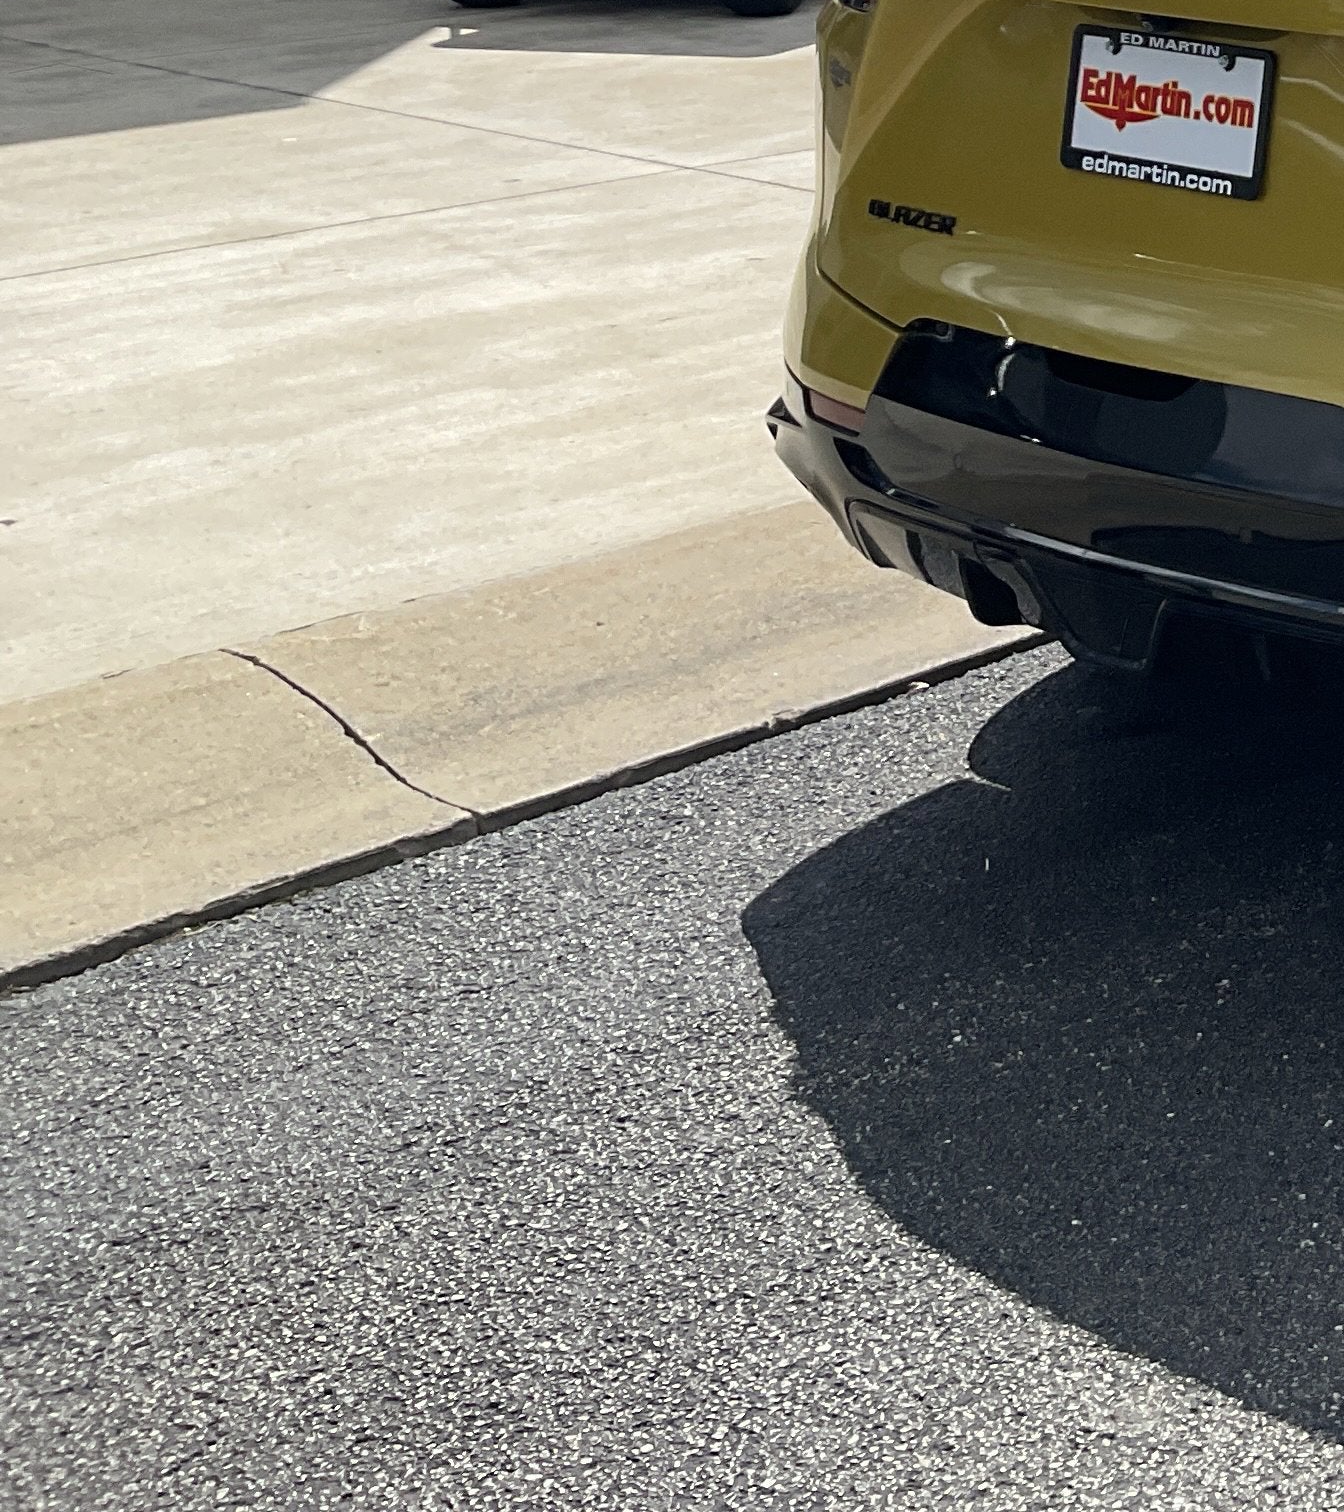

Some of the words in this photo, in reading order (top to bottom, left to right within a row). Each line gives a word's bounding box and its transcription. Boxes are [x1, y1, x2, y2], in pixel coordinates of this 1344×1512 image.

[1119, 32, 1144, 46] ED
[1149, 37, 1220, 57] MARTIN
[1080, 67, 1256, 129] EdMartin.com
[1082, 155, 1233, 196] edmartin.com
